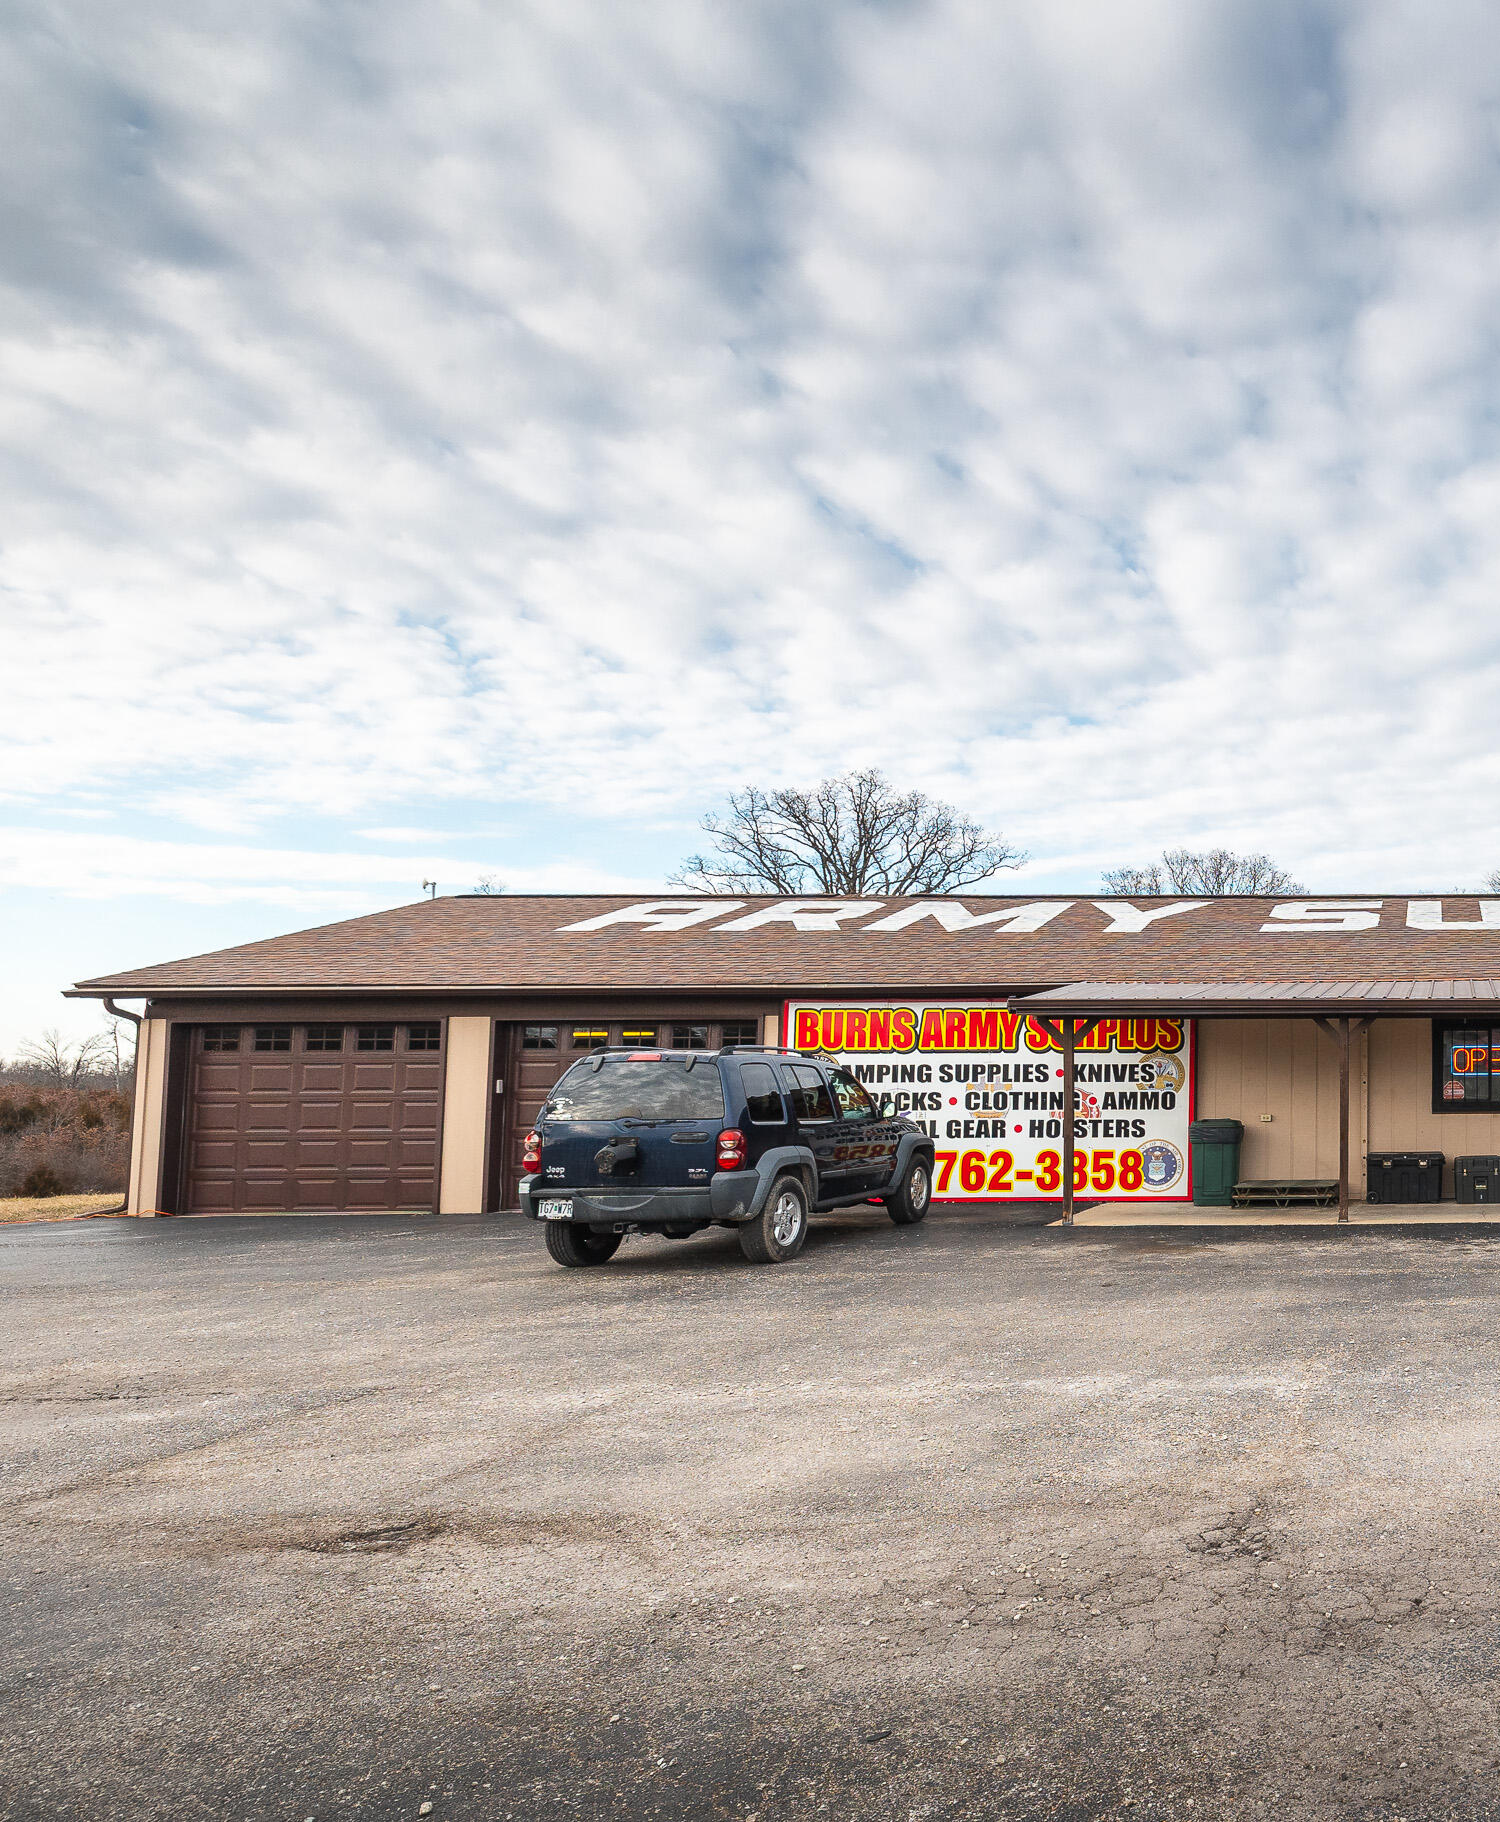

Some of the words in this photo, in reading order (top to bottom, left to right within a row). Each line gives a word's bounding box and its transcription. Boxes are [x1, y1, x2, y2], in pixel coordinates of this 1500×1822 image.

[553, 900, 1215, 932] ARMY
[795, 1008, 918, 1053] BURNS
[918, 1008, 1024, 1053] ARMY
[841, 1064, 932, 1083] MPING
[938, 1064, 1049, 1083] SUPPLIES
[1073, 1063, 1155, 1083] KNIVES
[1102, 1091, 1176, 1110] AMMO
[946, 1119, 1006, 1138] GEAR
[1029, 1119, 1146, 1138] HOSTERS
[546, 1165, 566, 1175] Jeep
